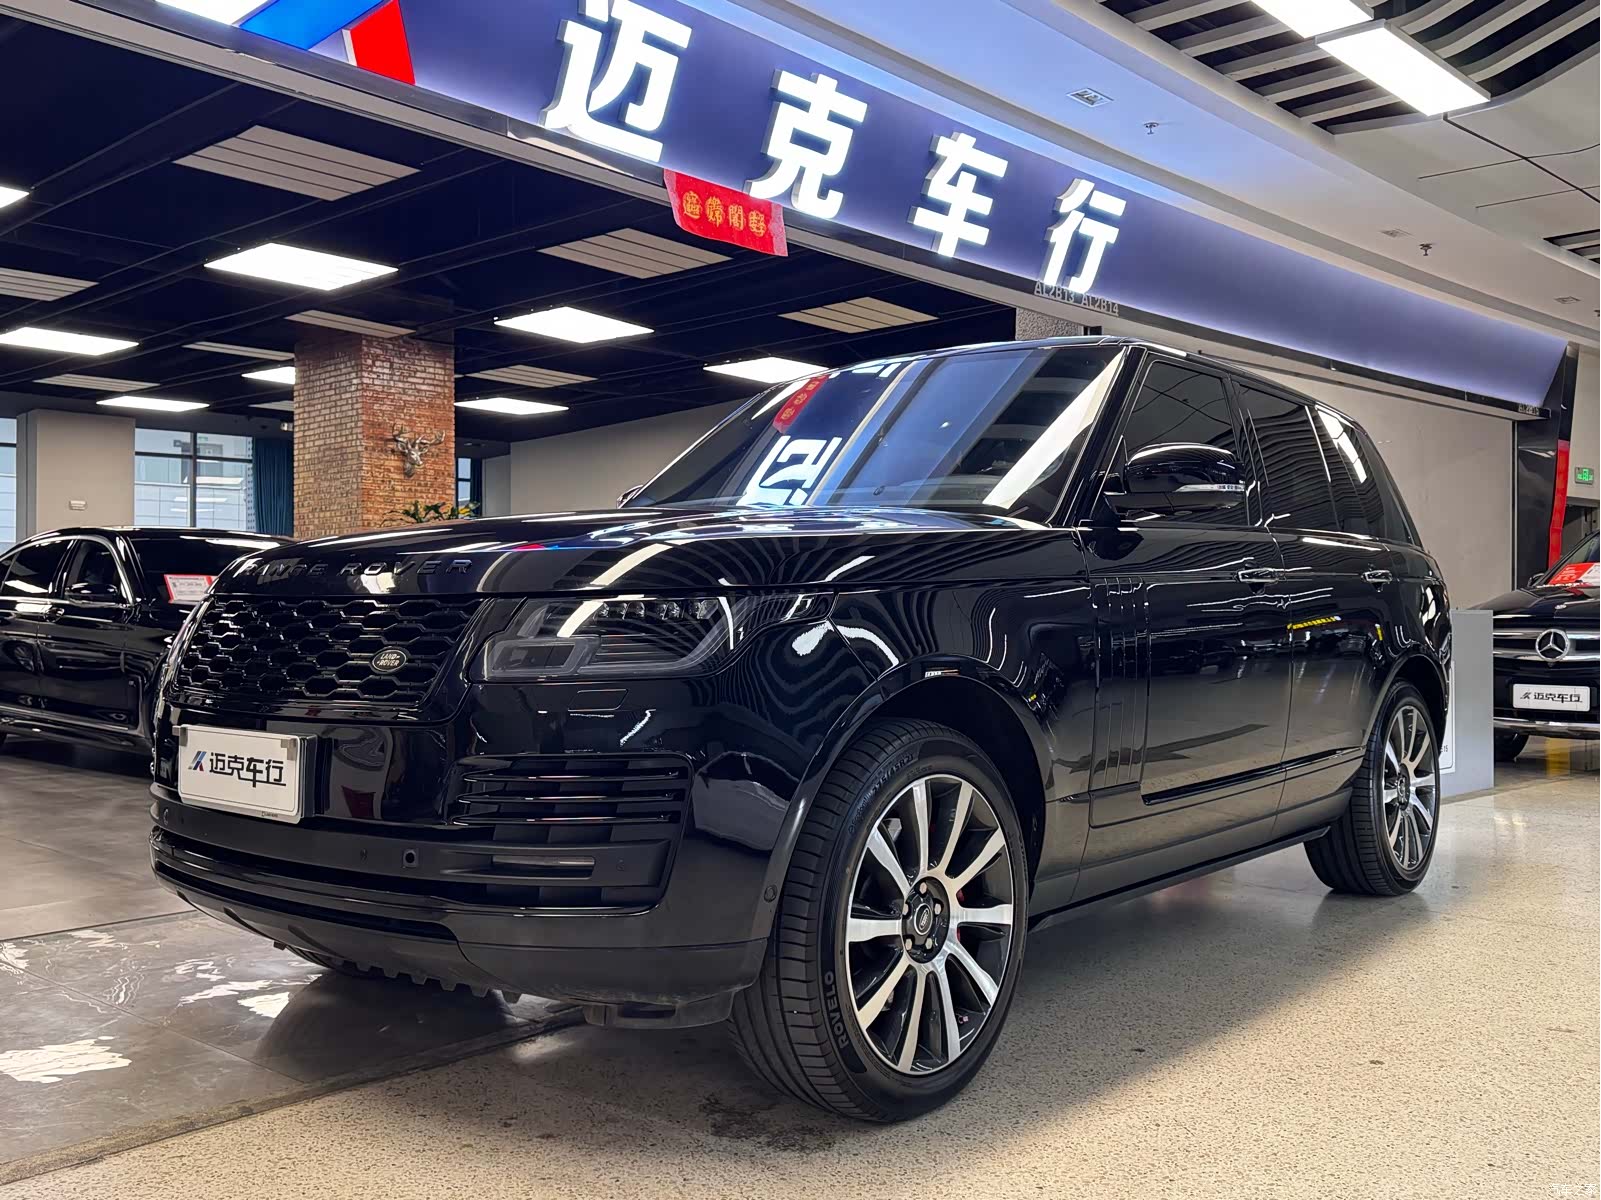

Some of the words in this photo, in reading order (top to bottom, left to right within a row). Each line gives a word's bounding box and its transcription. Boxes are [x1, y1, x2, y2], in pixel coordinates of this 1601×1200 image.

[541, 0, 1127, 295] 迈克车行
[1033, 280, 1075, 304] AL2B13
[1081, 293, 1119, 317] AL2B14
[337, 559, 473, 577] ROVER
[1533, 691, 1583, 704] 迈克车行
[209, 752, 287, 788] 迈克车行
[824, 970, 850, 1049] ROVELO
